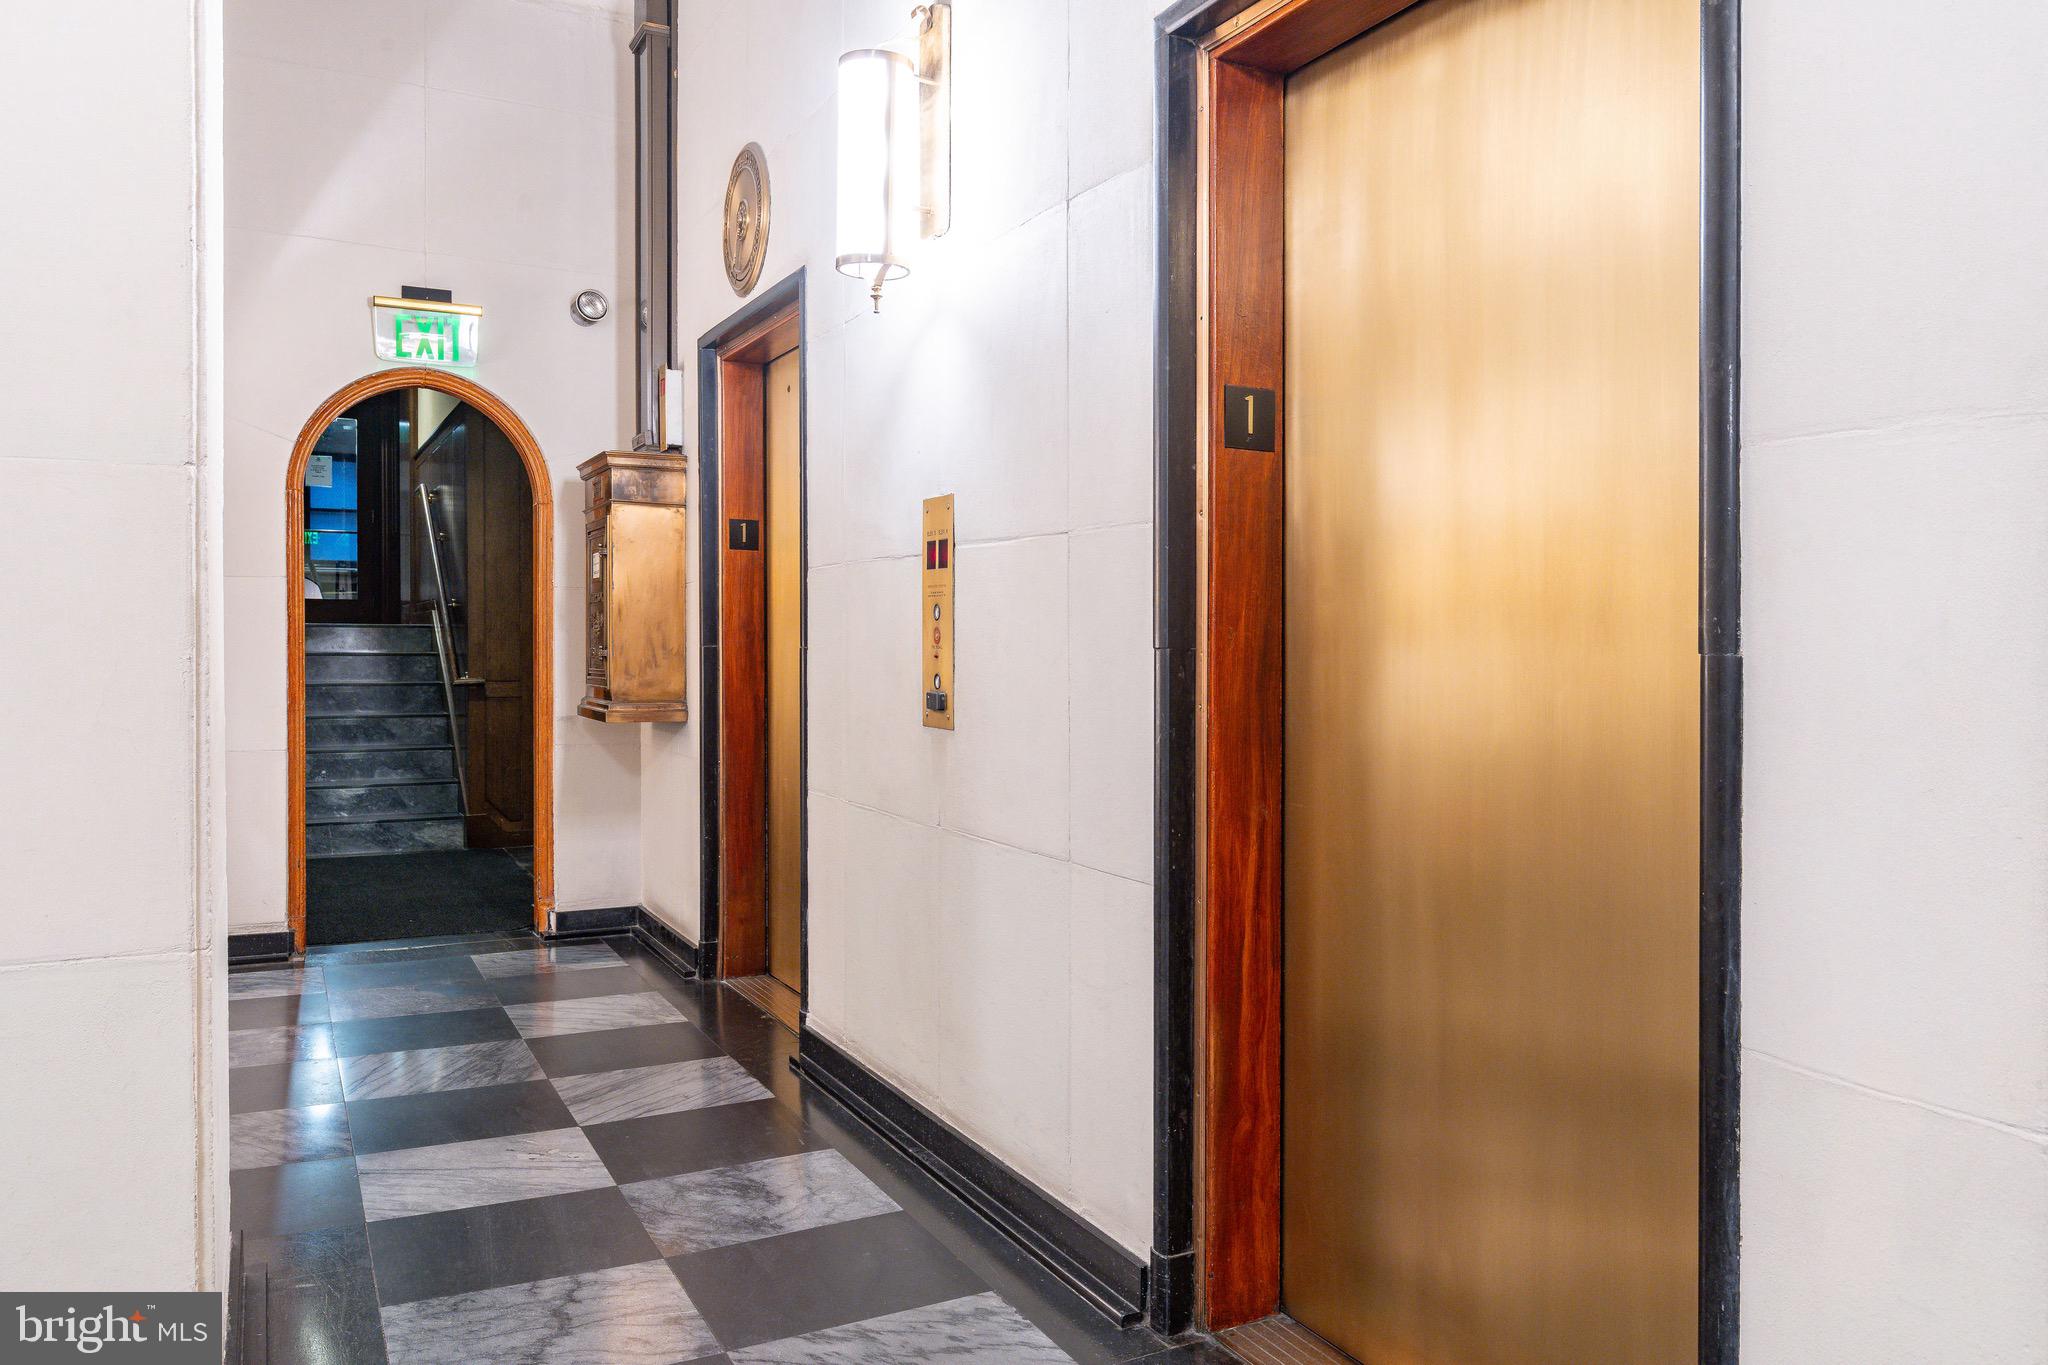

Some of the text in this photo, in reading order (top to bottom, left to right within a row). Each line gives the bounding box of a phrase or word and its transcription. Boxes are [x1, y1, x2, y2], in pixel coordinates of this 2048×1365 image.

[394, 314, 460, 361] EXIT
[1244, 395, 1254, 434] 1
[740, 522, 747, 543] 1
